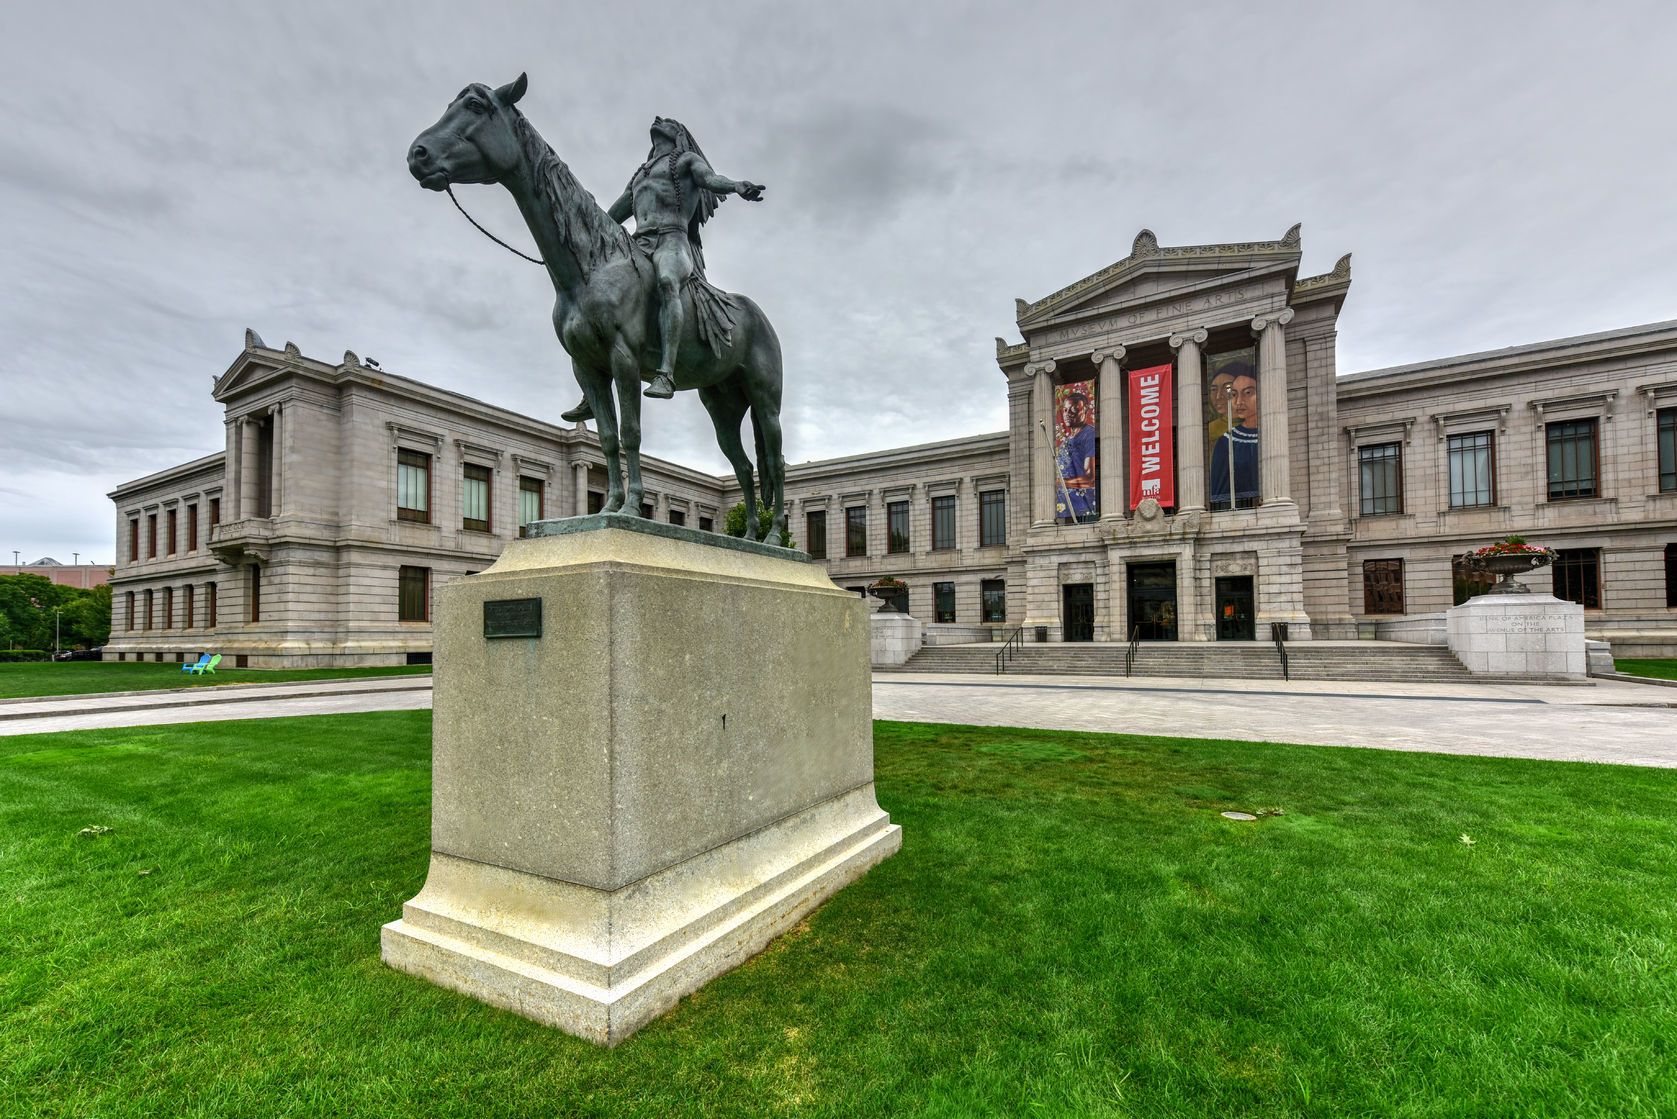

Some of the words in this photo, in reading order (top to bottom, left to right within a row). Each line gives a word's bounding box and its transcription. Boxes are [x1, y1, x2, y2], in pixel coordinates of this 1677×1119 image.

[1127, 312, 1145, 324] OF
[1154, 301, 1193, 319] FINE
[1204, 289, 1245, 305] ARTS
[1140, 373, 1161, 475] WELCOME
